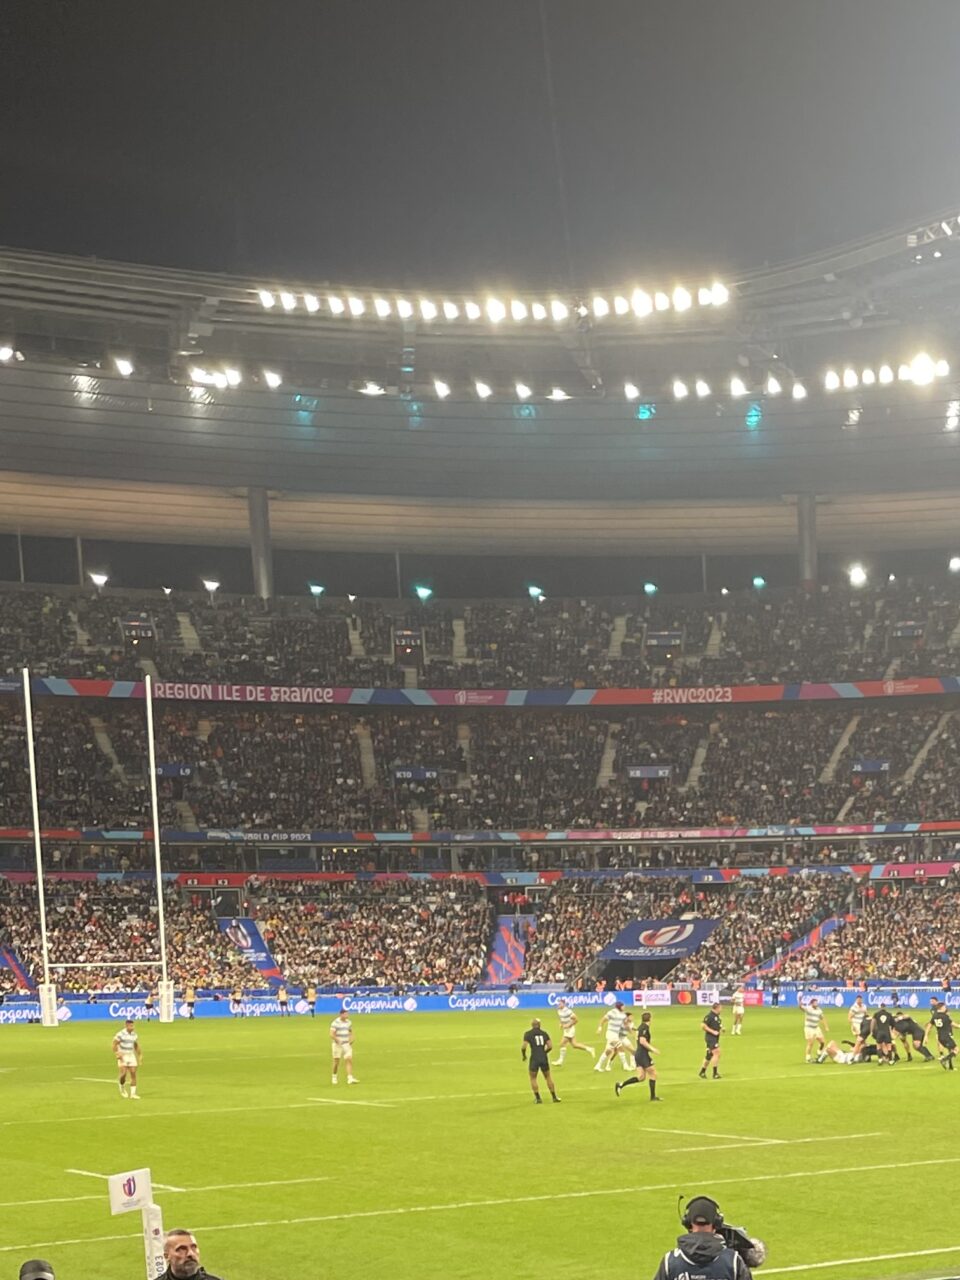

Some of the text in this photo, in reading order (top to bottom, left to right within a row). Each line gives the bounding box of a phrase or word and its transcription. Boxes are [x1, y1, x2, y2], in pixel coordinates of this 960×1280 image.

[153, 682, 214, 700] REGION
[219, 684, 243, 701] ILE
[246, 685, 267, 702] DE
[652, 687, 733, 704] #RWC2023
[342, 997, 403, 1014] Capgemini
[448, 994, 506, 1011] Capgemini
[934, 1018, 944, 1028] 15
[534, 1035, 545, 1046] 11
